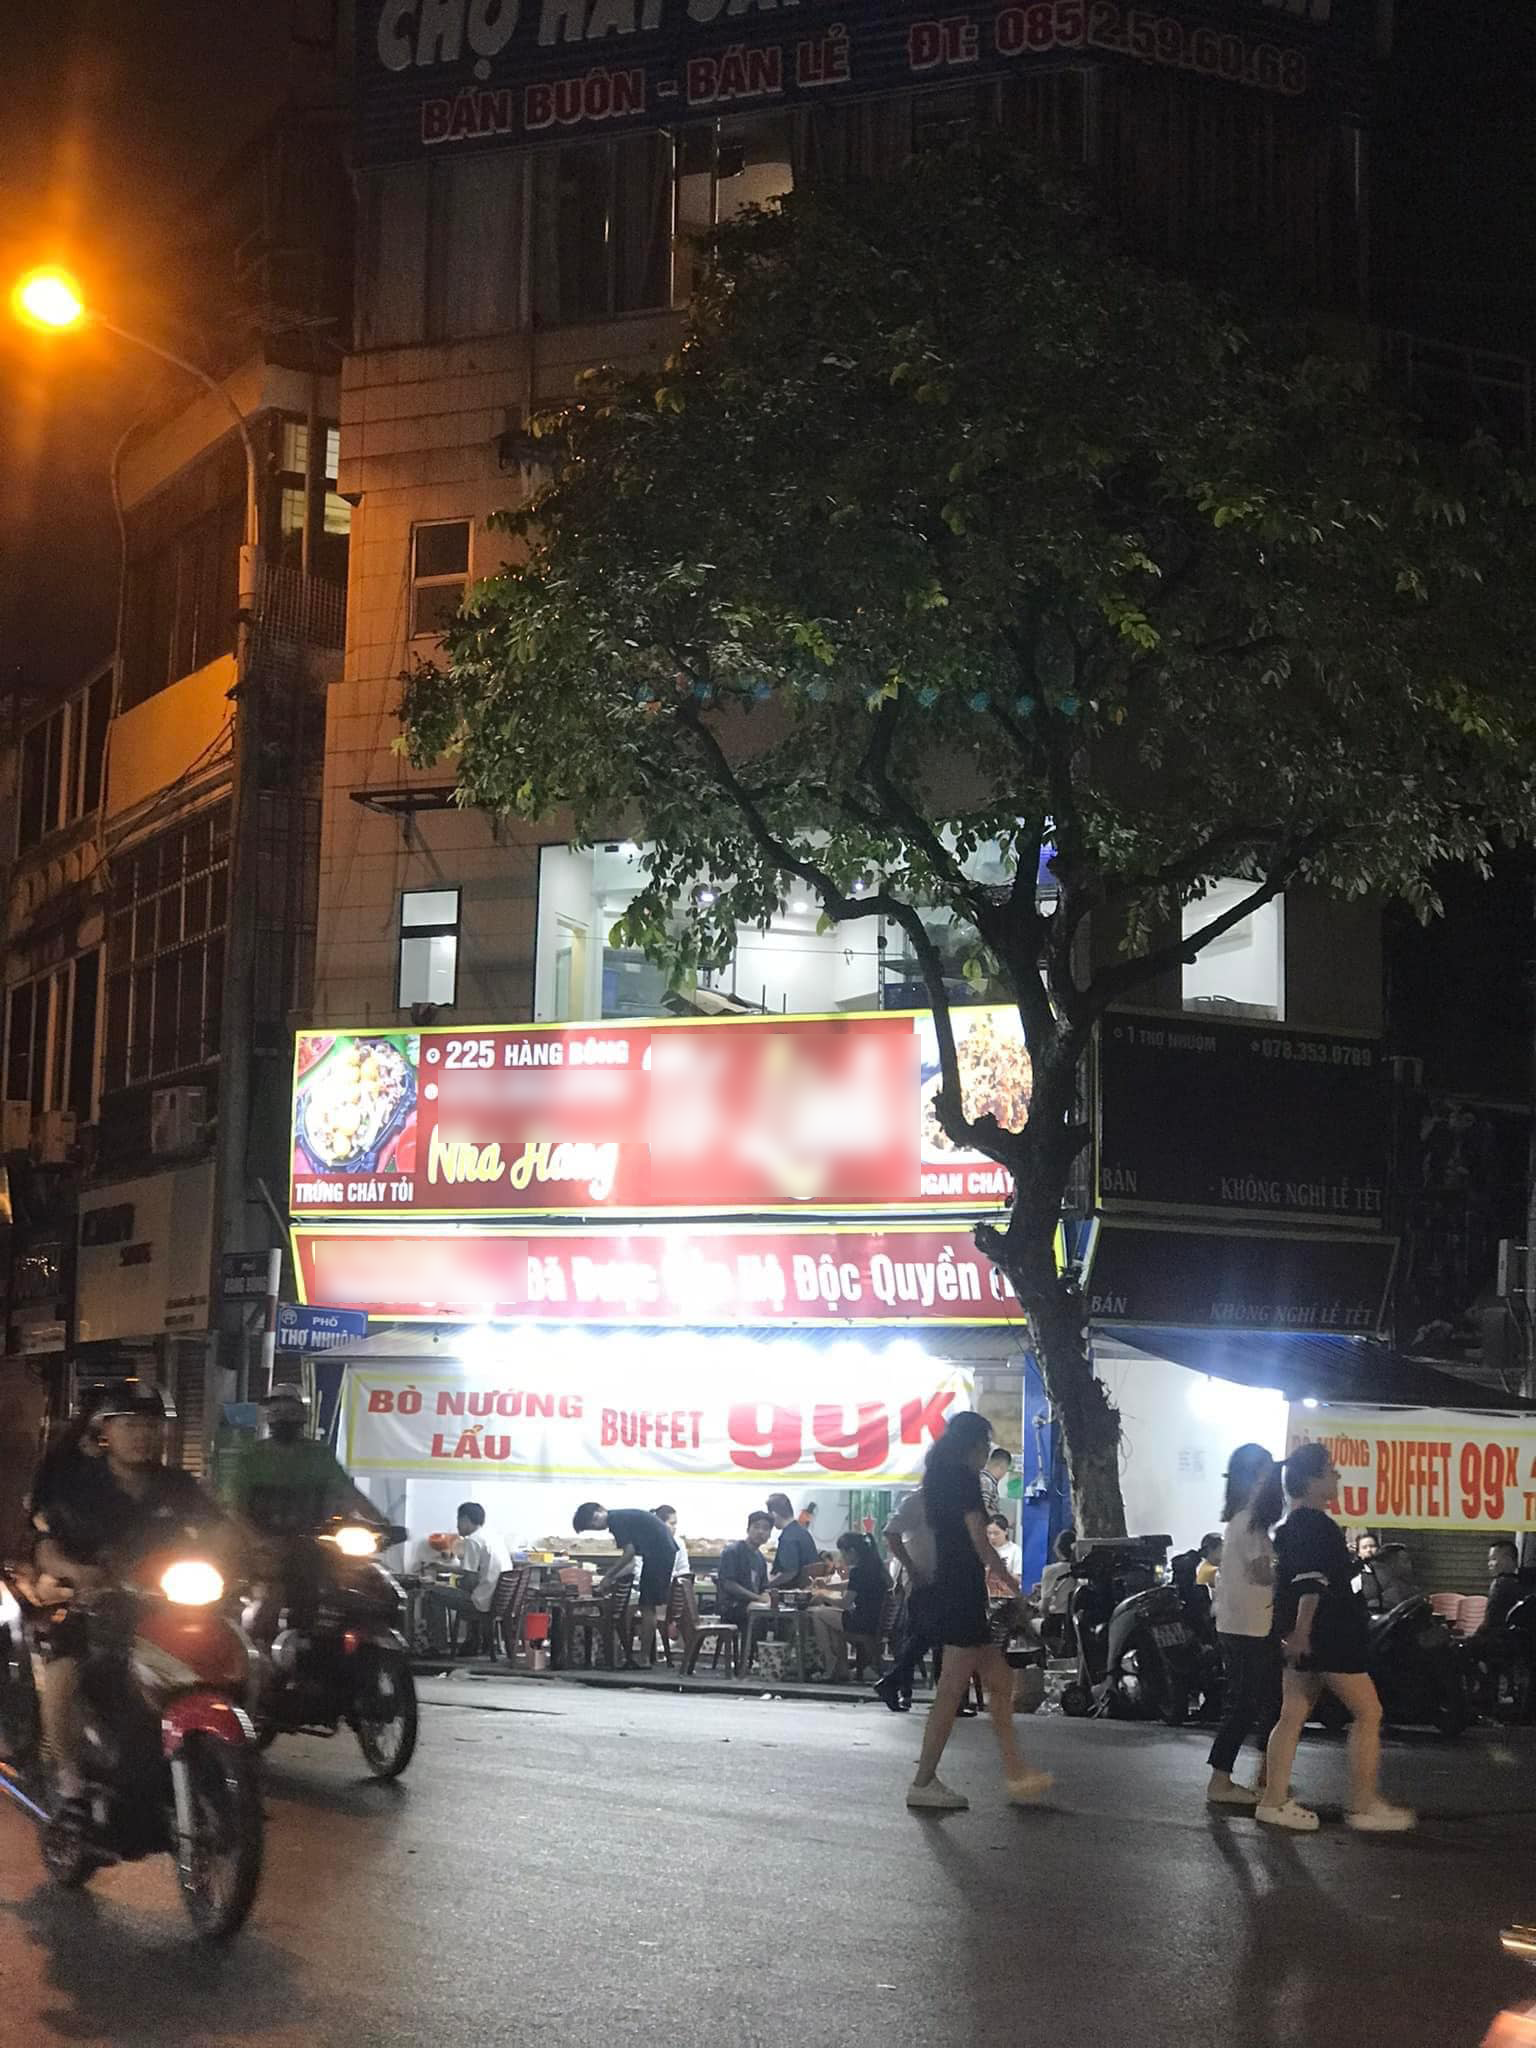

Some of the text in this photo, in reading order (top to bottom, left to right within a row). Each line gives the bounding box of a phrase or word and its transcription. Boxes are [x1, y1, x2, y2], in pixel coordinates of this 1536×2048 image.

[420, 86, 513, 144] BÁN
[523, 66, 646, 130] BUÔN
[687, 43, 783, 105] BÁN
[796, 22, 851, 88] LẺ
[445, 1040, 495, 1069] 225
[505, 1040, 563, 1066] HÀNG
[295, 1176, 414, 1202] TRỨNG CHÁY TỎI
[792, 1253, 863, 1311] Độc
[869, 1245, 981, 1307] Quyền
[312, 1315, 339, 1327] PHỐ
[280, 1328, 309, 1350] THỢ
[367, 1385, 584, 1418] BÒ NƯỚNG
[600, 1407, 704, 1449] BUFFET
[1375, 1440, 1452, 1517] BUFFET
